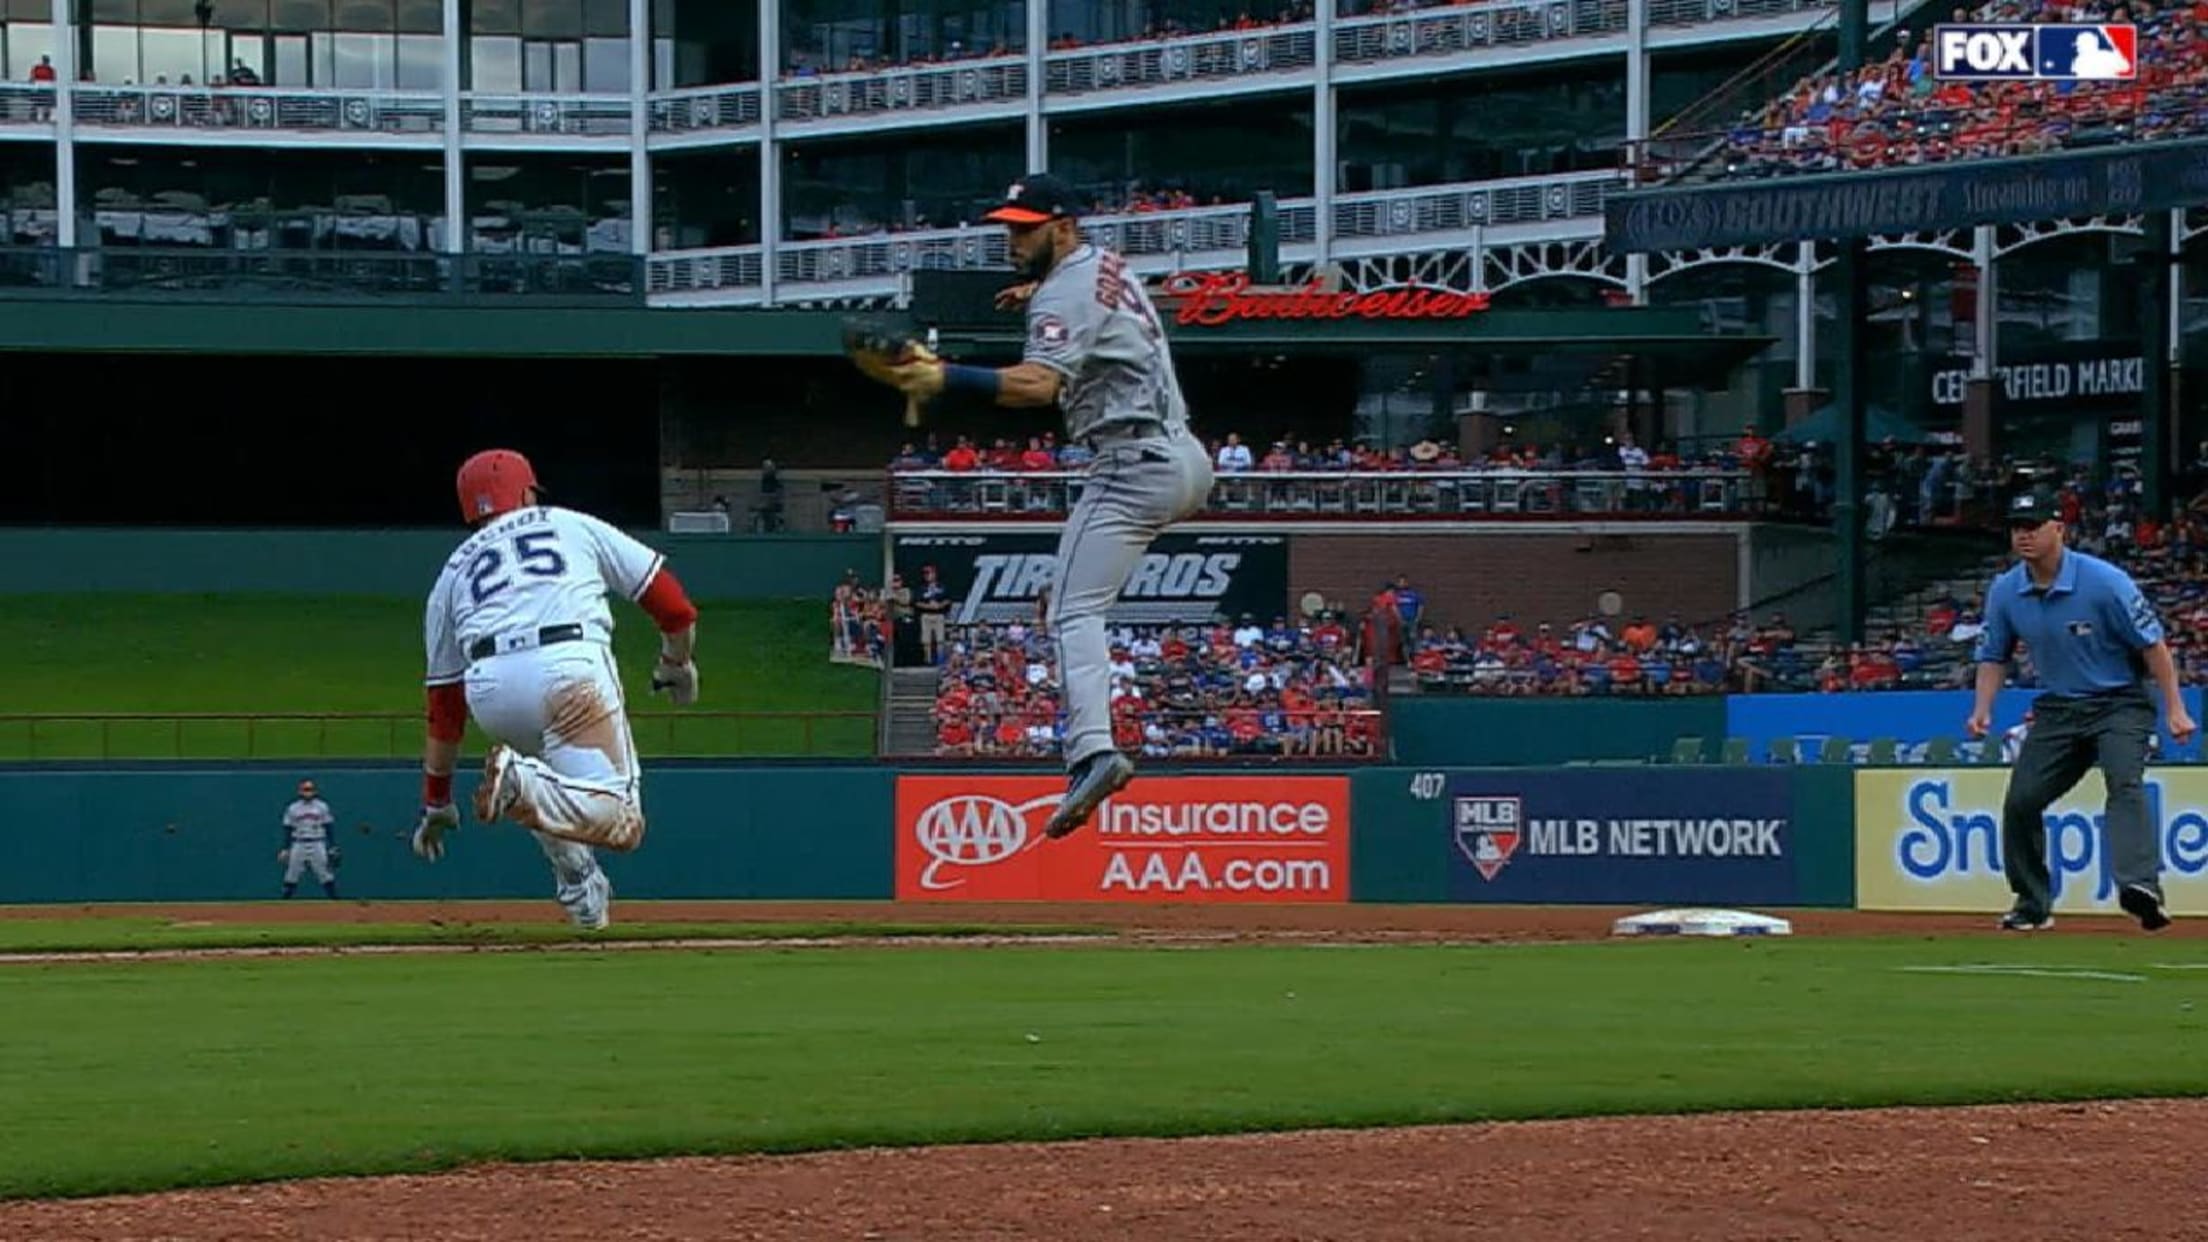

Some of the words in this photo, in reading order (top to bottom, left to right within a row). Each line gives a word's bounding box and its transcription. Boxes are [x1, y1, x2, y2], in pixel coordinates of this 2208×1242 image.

[1162, 271, 1491, 326] Budweiser
[464, 530, 567, 603] 25
[957, 552, 1058, 624] TIR
[1122, 551, 1243, 597] ROS
[1409, 773, 1445, 799] 407
[933, 801, 1014, 859] AAA
[1099, 799, 1330, 835] Insurance
[1460, 801, 1516, 824] MLB
[1529, 819, 1600, 856] MLB
[1608, 818, 1783, 857] NETWORK
[1100, 852, 1331, 891] AAA.com
